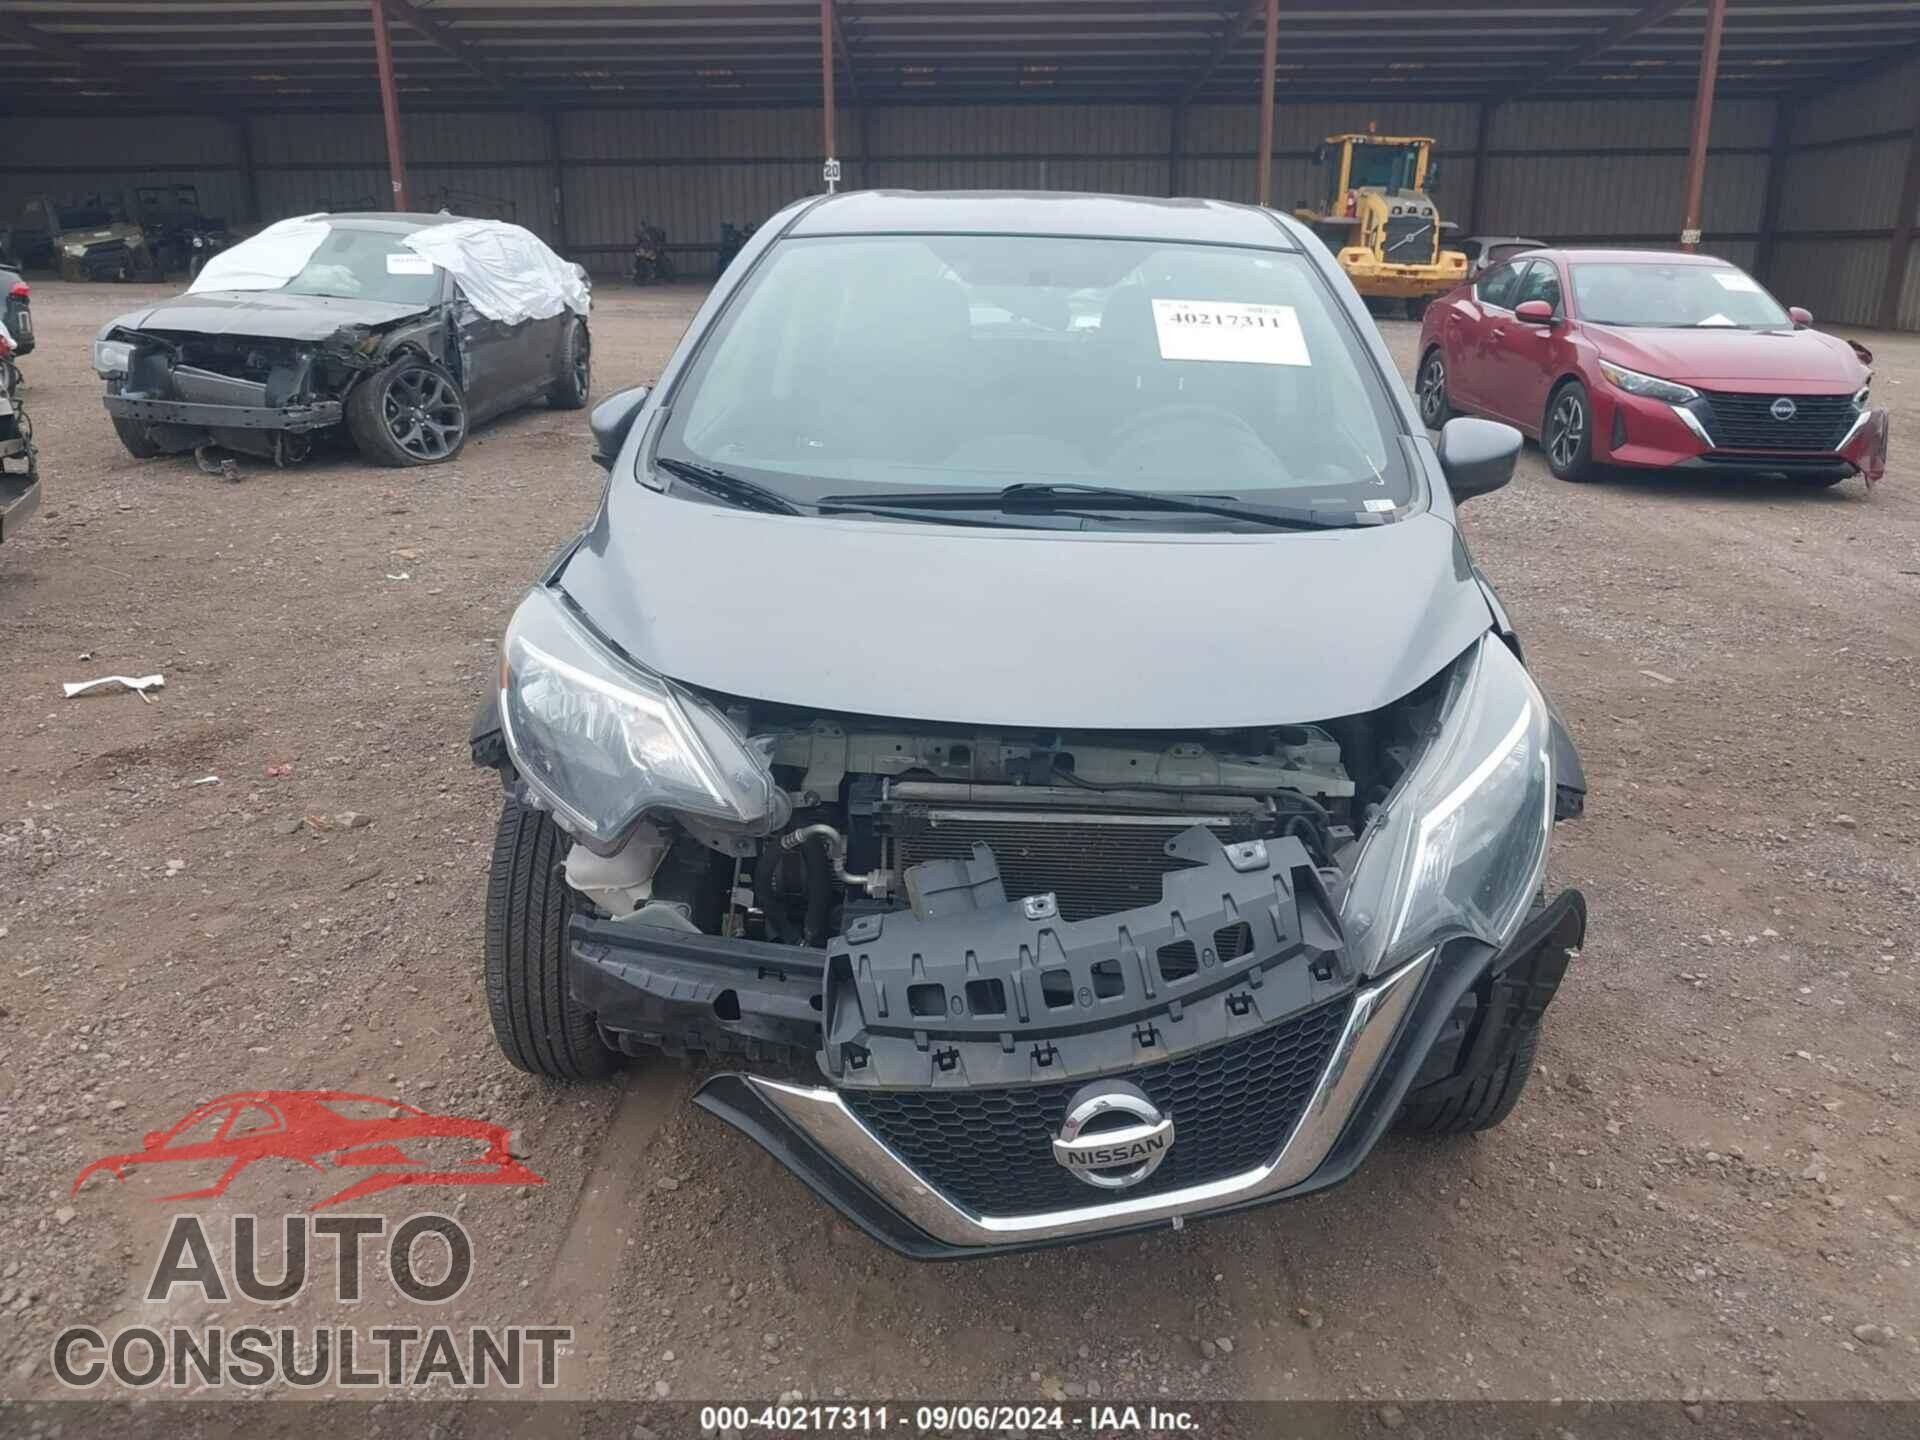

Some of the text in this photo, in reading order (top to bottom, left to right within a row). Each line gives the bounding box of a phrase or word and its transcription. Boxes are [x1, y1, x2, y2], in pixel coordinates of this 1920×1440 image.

[825, 164, 839, 177] 20
[1170, 312, 1280, 328] 40217311
[1067, 1134, 1164, 1165] NISSAN
